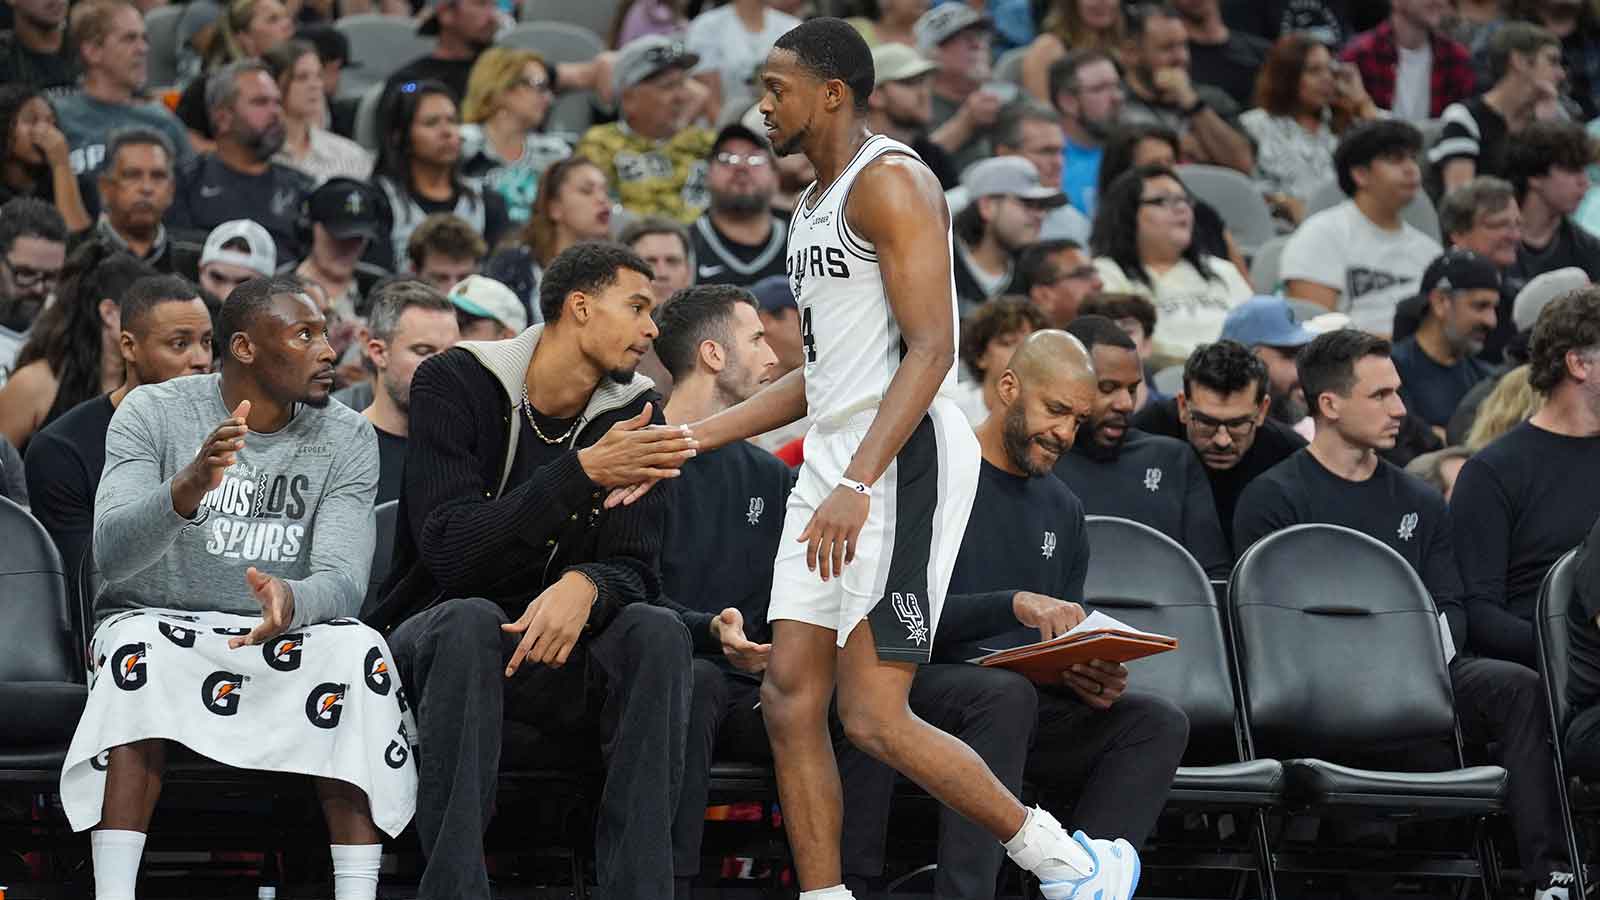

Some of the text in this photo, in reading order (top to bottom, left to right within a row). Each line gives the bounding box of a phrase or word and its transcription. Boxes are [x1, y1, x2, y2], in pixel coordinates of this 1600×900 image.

[206, 516, 305, 562] SPURS
[111, 642, 148, 691] G
[262, 632, 304, 672] G
[201, 671, 243, 716] G
[305, 682, 346, 729] G
